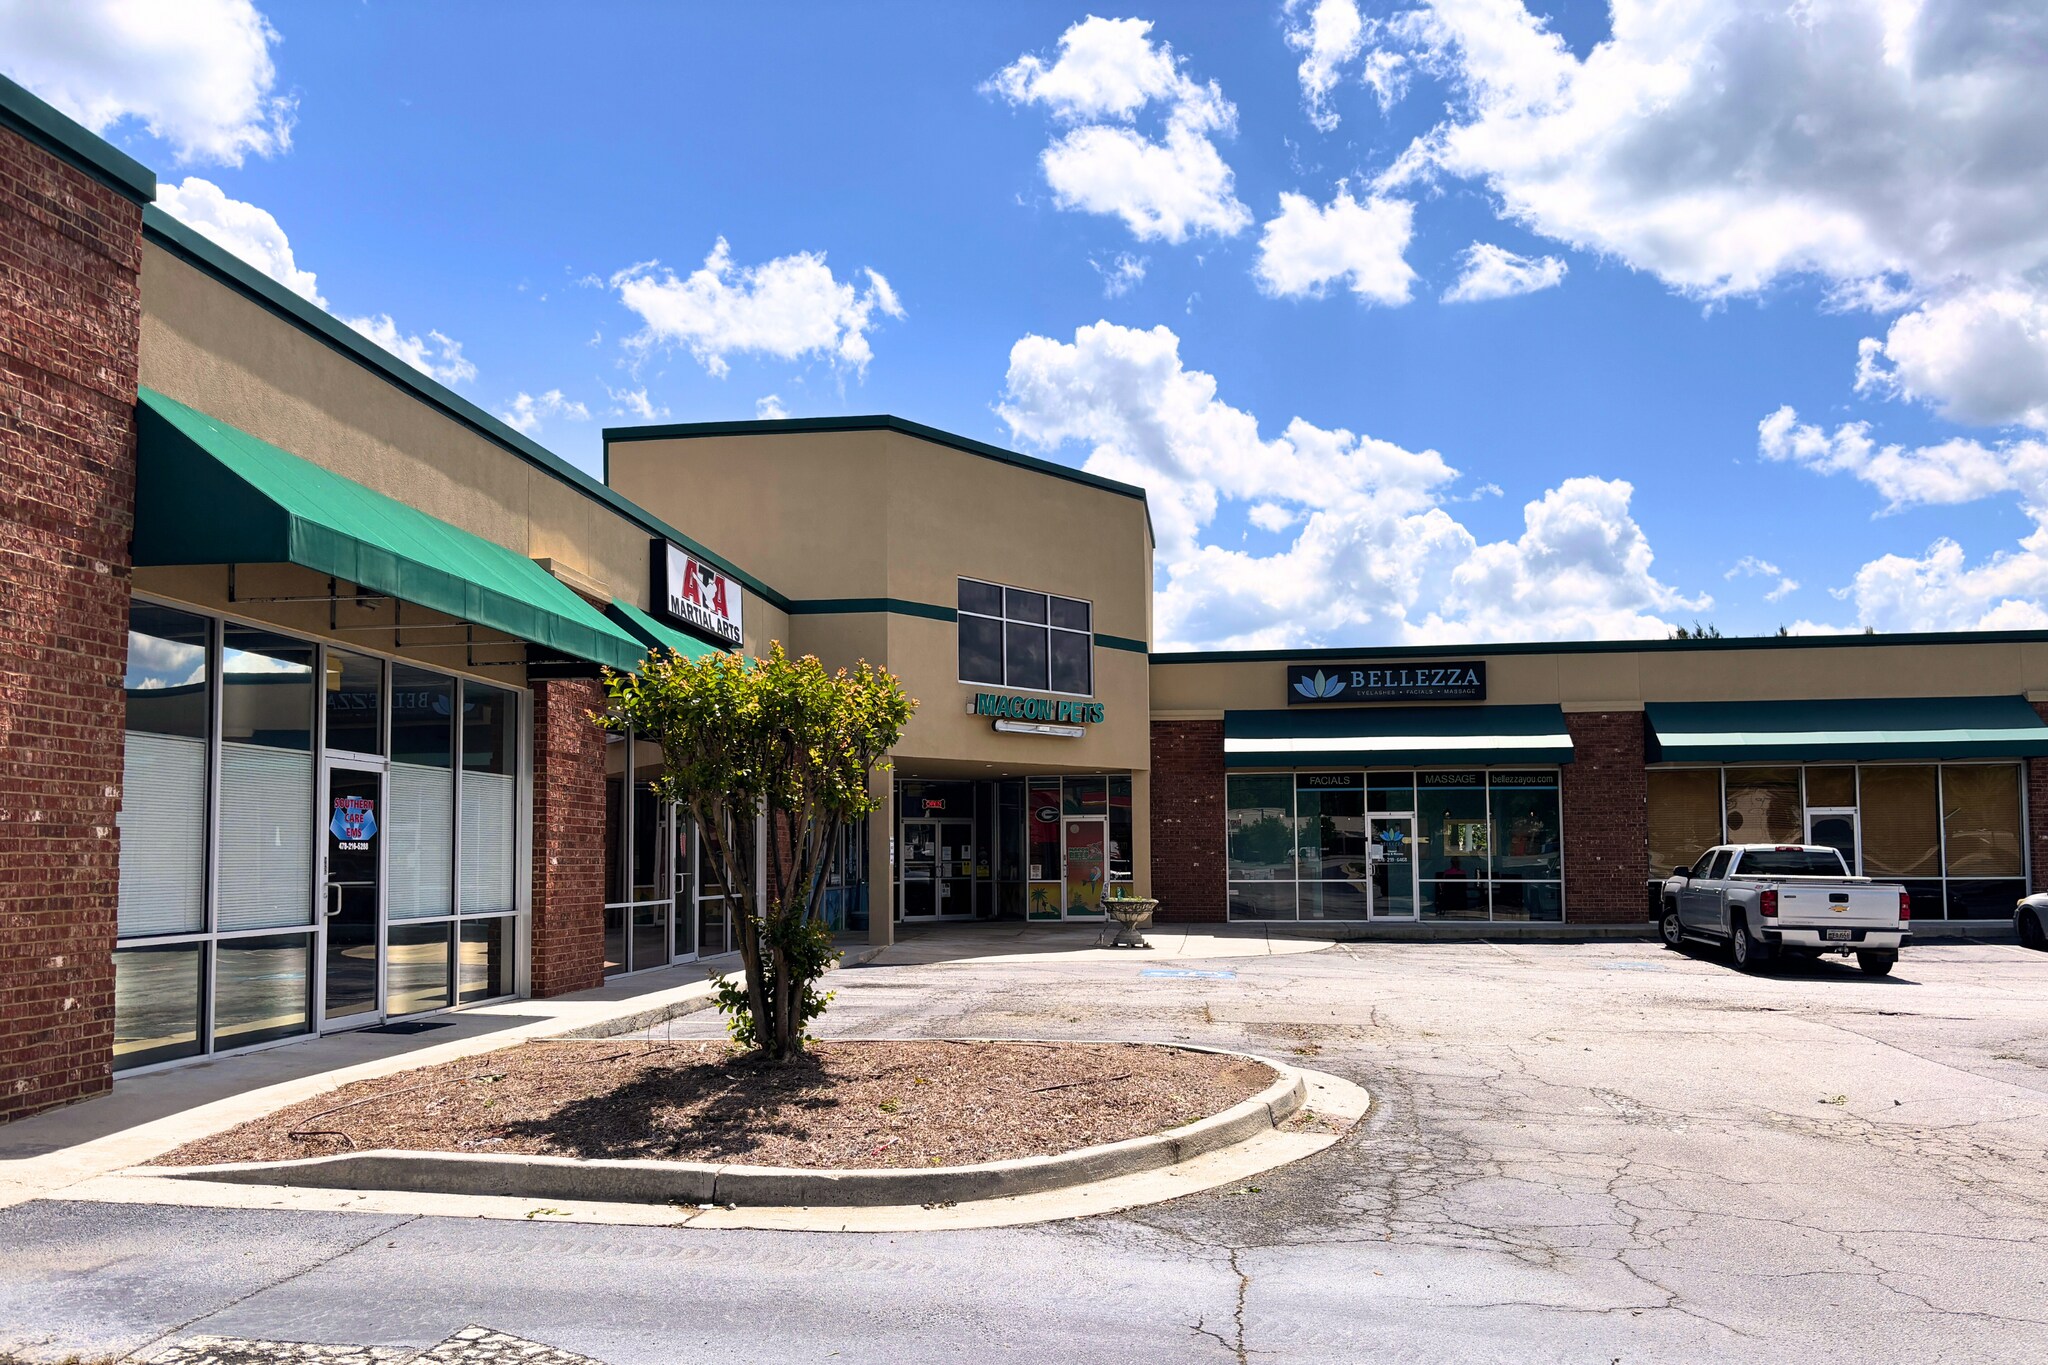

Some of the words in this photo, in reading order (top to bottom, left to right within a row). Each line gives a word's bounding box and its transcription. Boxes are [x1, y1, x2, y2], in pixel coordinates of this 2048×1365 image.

[682, 557, 729, 620] ATA
[670, 594, 715, 630] MARTIAL
[717, 618, 740, 642] ARTS
[1350, 668, 1480, 688] BELLEZZA
[976, 693, 1052, 720] MACON
[1058, 700, 1105, 723] PETS
[1310, 776, 1350, 785] FACIALS
[1425, 775, 1476, 784] MASSAGE
[1492, 775, 1553, 785] bellezzayou.com
[334, 798, 374, 810] SOUTHERN
[344, 813, 364, 823] CARE
[345, 828, 362, 839] EMS
